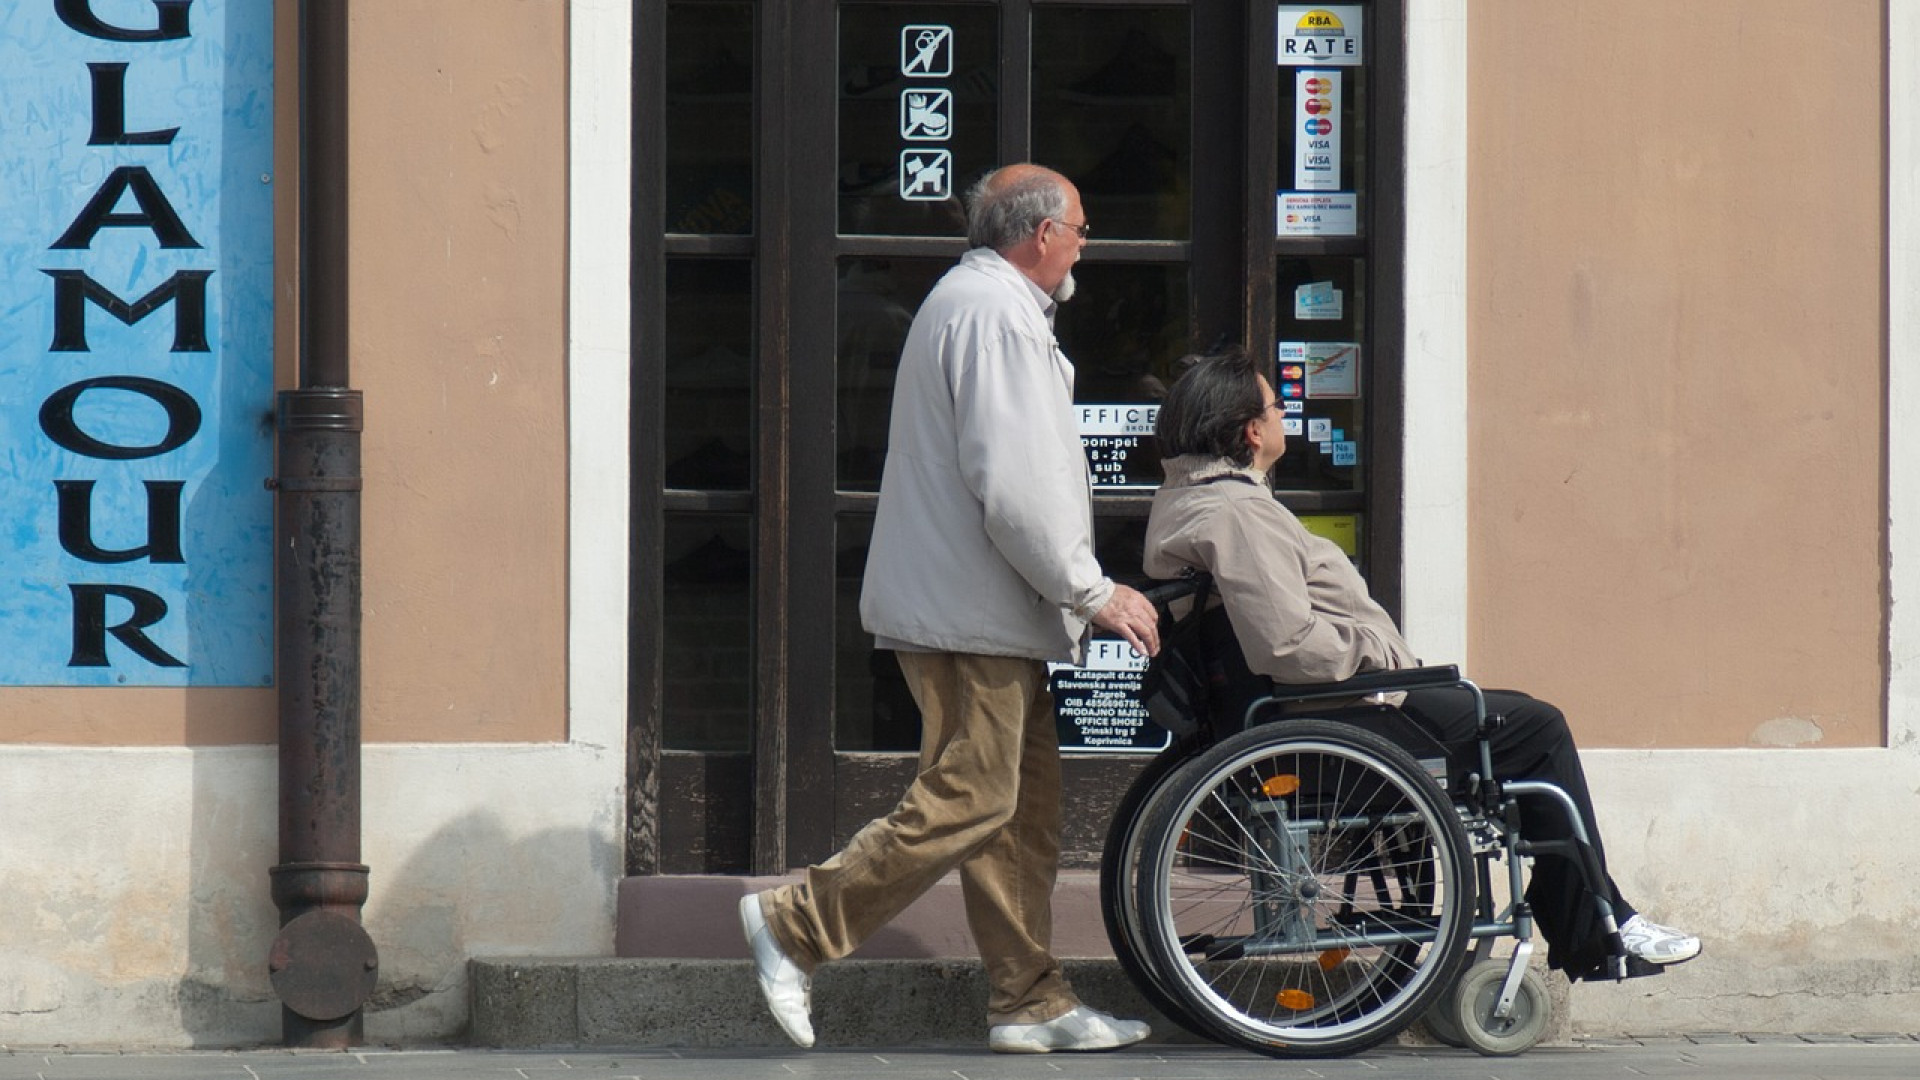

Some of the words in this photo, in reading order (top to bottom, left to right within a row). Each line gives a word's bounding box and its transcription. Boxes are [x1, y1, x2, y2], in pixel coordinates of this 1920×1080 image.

[1308, 16, 1331, 25] RBA
[1285, 38, 1354, 54] RATE
[1308, 140, 1330, 149] VISA
[1308, 155, 1330, 164] VISA
[1083, 409, 1155, 423] FFICE
[1336, 443, 1348, 452] Na
[1091, 450, 1099, 460] 8
[1111, 450, 1127, 460] 20
[1336, 453, 1354, 461] rate
[1095, 462, 1122, 472] sub
[1091, 474, 1098, 484] 8
[1111, 474, 1126, 484] 13
[1074, 671, 1115, 681] Katapult
[1057, 680, 1106, 689] Slavonska
[1108, 681, 1142, 691] avenija
[1092, 690, 1126, 700] Zagreb
[1060, 708, 1115, 717] PRODAJNO
[1074, 717, 1108, 726] OFFICE
[1081, 727, 1113, 735] Zrinski
[1114, 727, 1128, 737] trg
[1084, 737, 1133, 746] Koprivnica
